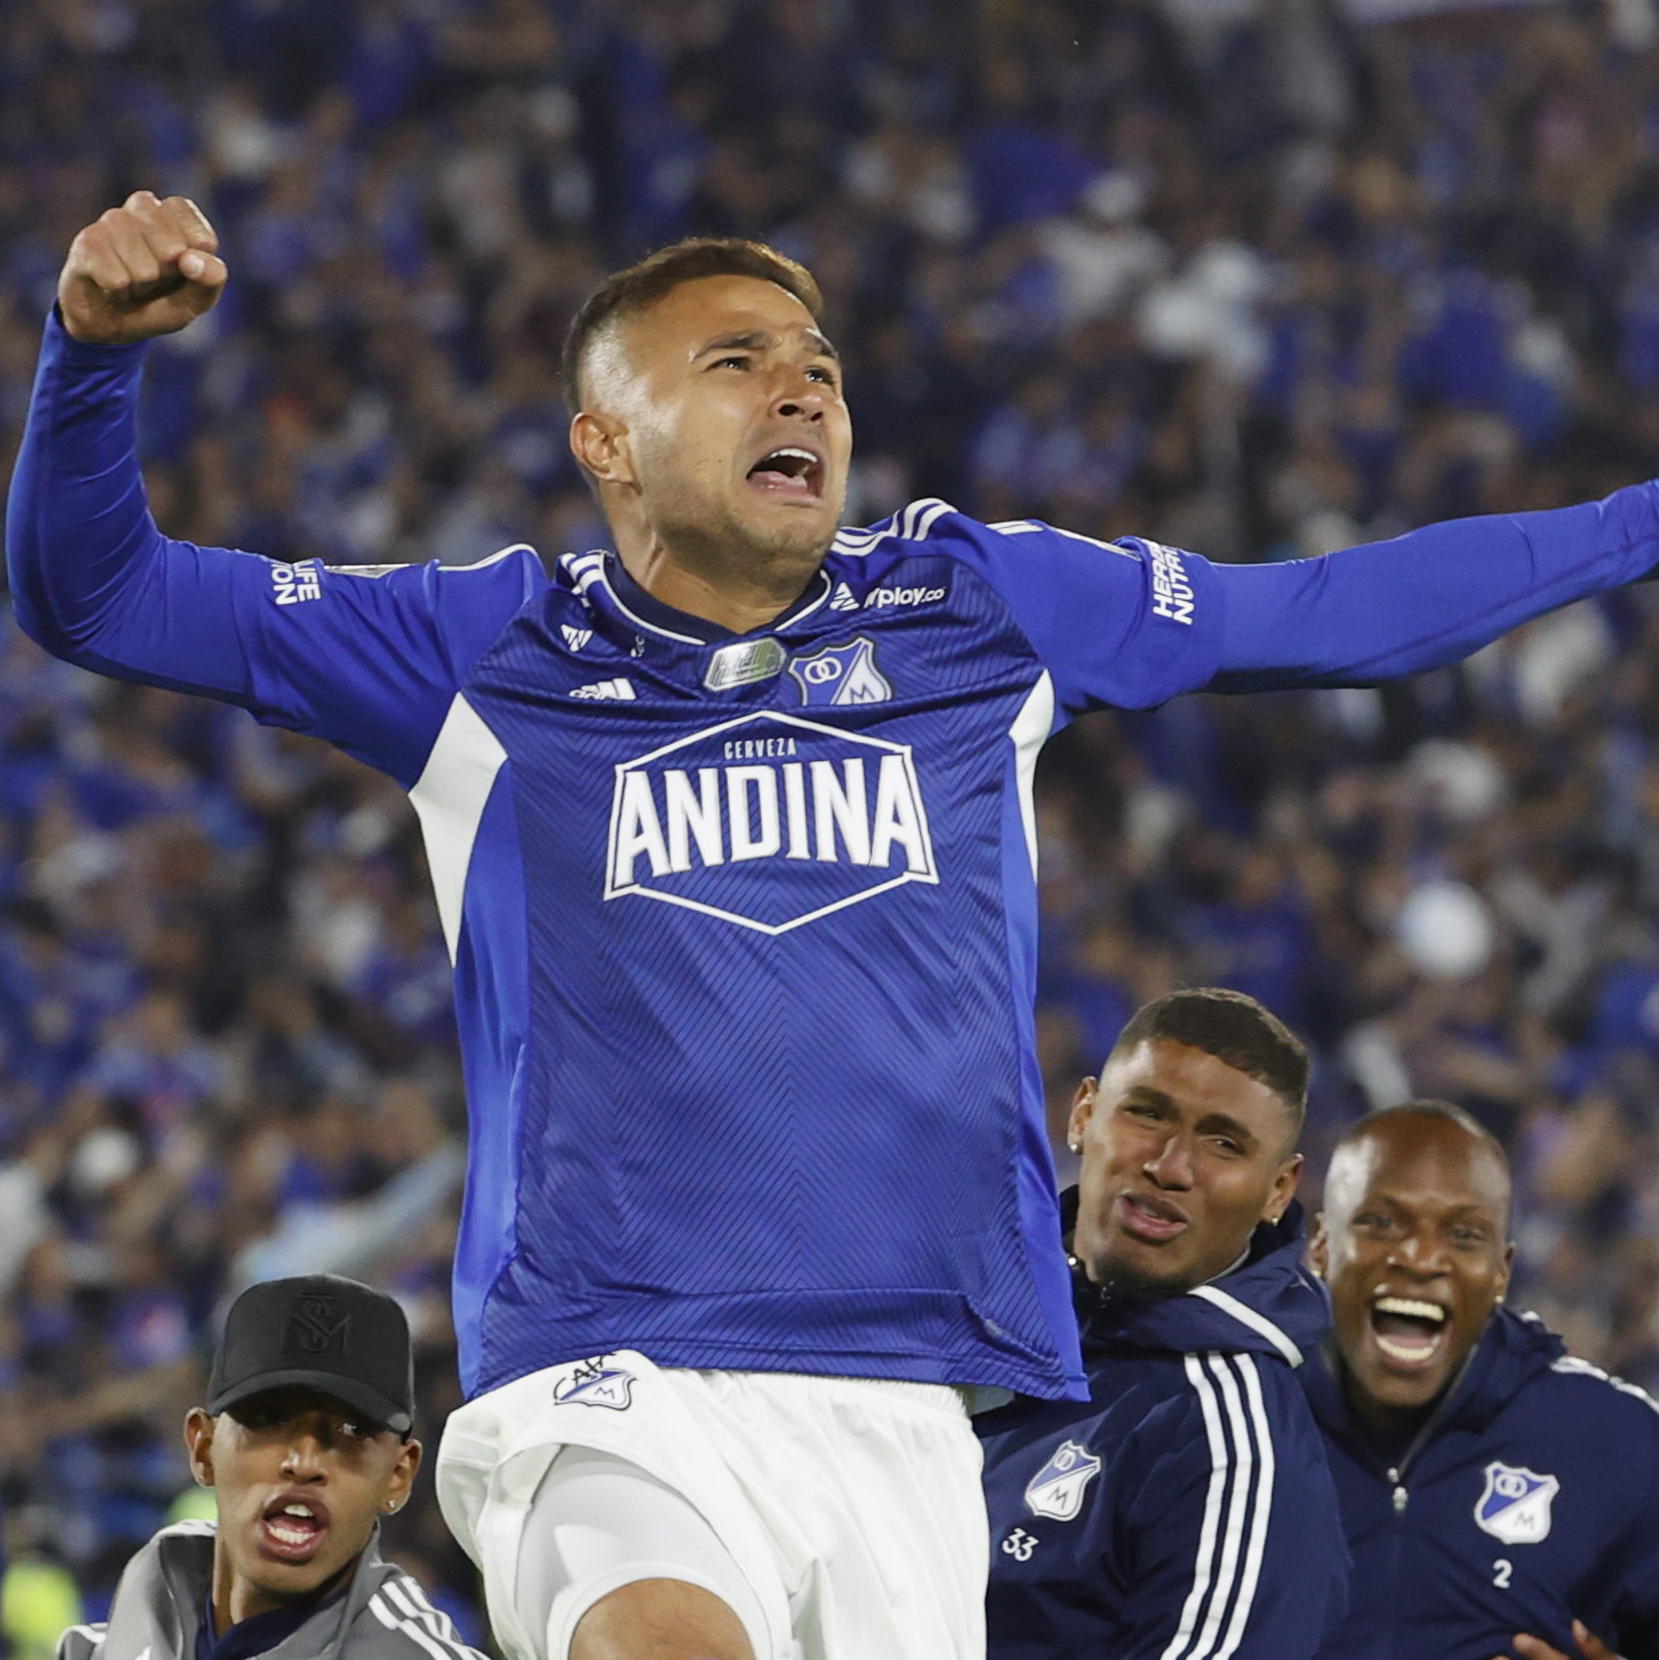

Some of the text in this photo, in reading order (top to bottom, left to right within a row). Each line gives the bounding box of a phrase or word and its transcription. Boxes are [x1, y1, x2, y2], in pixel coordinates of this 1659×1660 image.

[724, 737, 797, 760] CERVEZA
[613, 755, 929, 889] ANDINA
[1001, 1527, 1040, 1562] 33
[1492, 1558, 1513, 1589] 2
